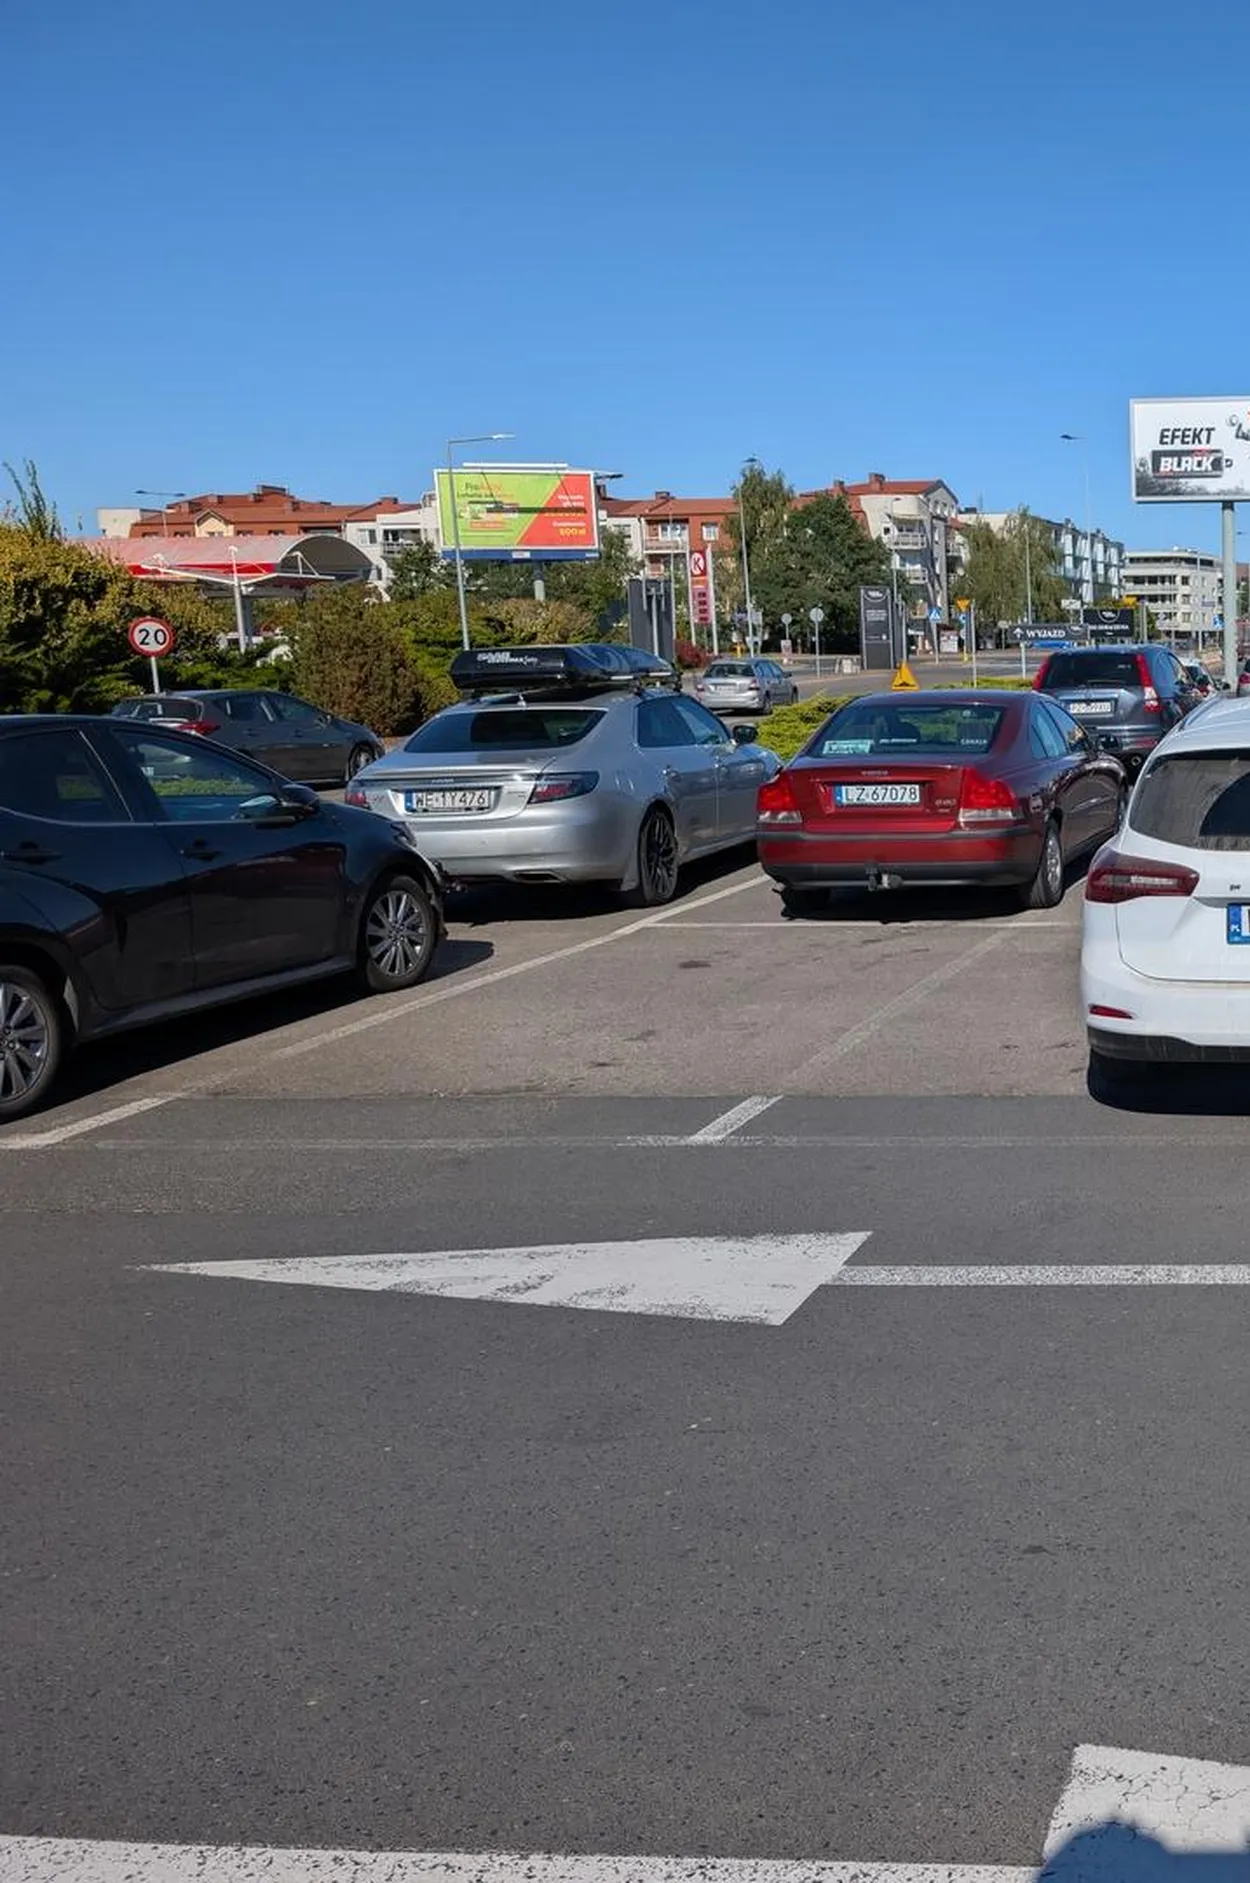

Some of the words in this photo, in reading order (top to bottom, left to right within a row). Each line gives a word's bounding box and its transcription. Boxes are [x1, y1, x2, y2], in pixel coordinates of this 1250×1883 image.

[1159, 427, 1215, 446] EFEKT
[1160, 456, 1214, 472] BLACK
[139, 628, 167, 646] 20
[1026, 629, 1066, 639] WYJAZD
[845, 787, 867, 802] LZ
[871, 786, 918, 802] 67078
